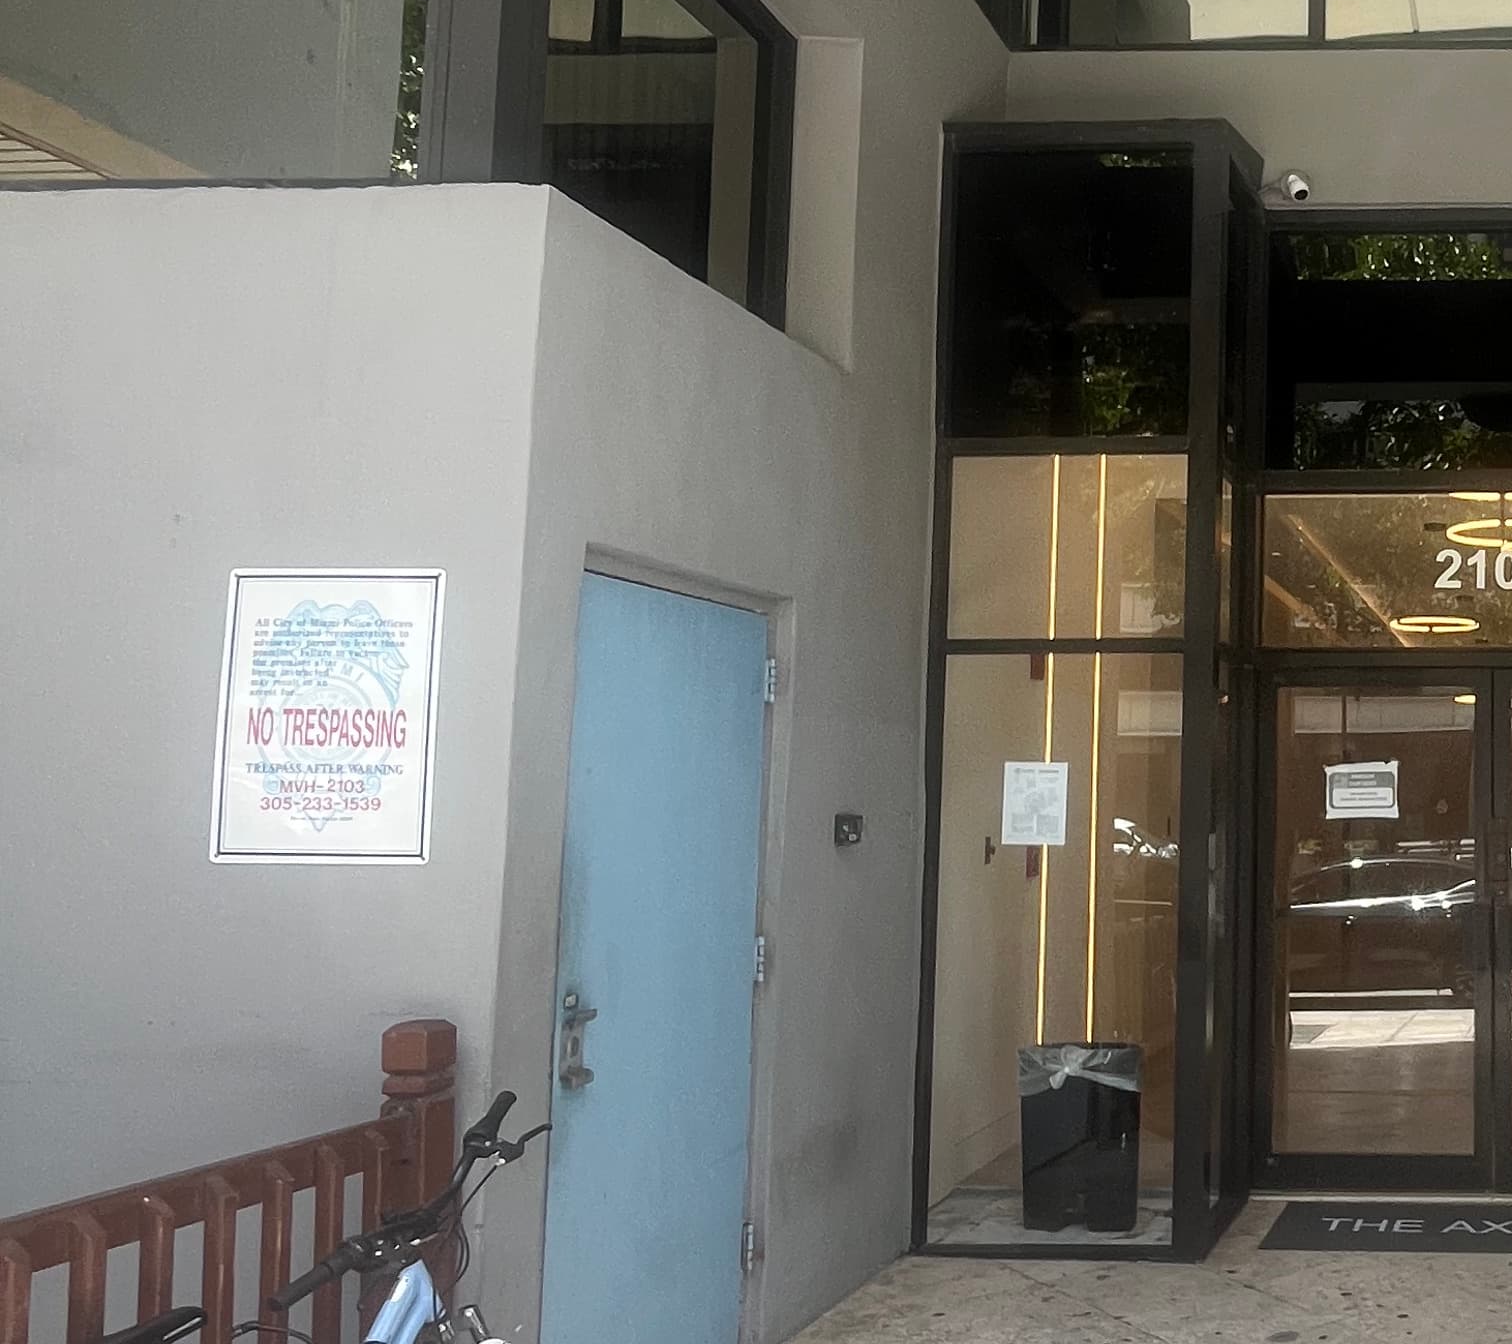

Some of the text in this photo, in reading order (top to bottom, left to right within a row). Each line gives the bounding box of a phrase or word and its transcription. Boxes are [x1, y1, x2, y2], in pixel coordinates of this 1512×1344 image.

[247, 707, 407, 748] NO TRESPASSING
[245, 762, 404, 775] TRESPASS AFTER WARNING
[260, 797, 382, 811] 305-233-1539
[1320, 1217, 1425, 1234] THE
